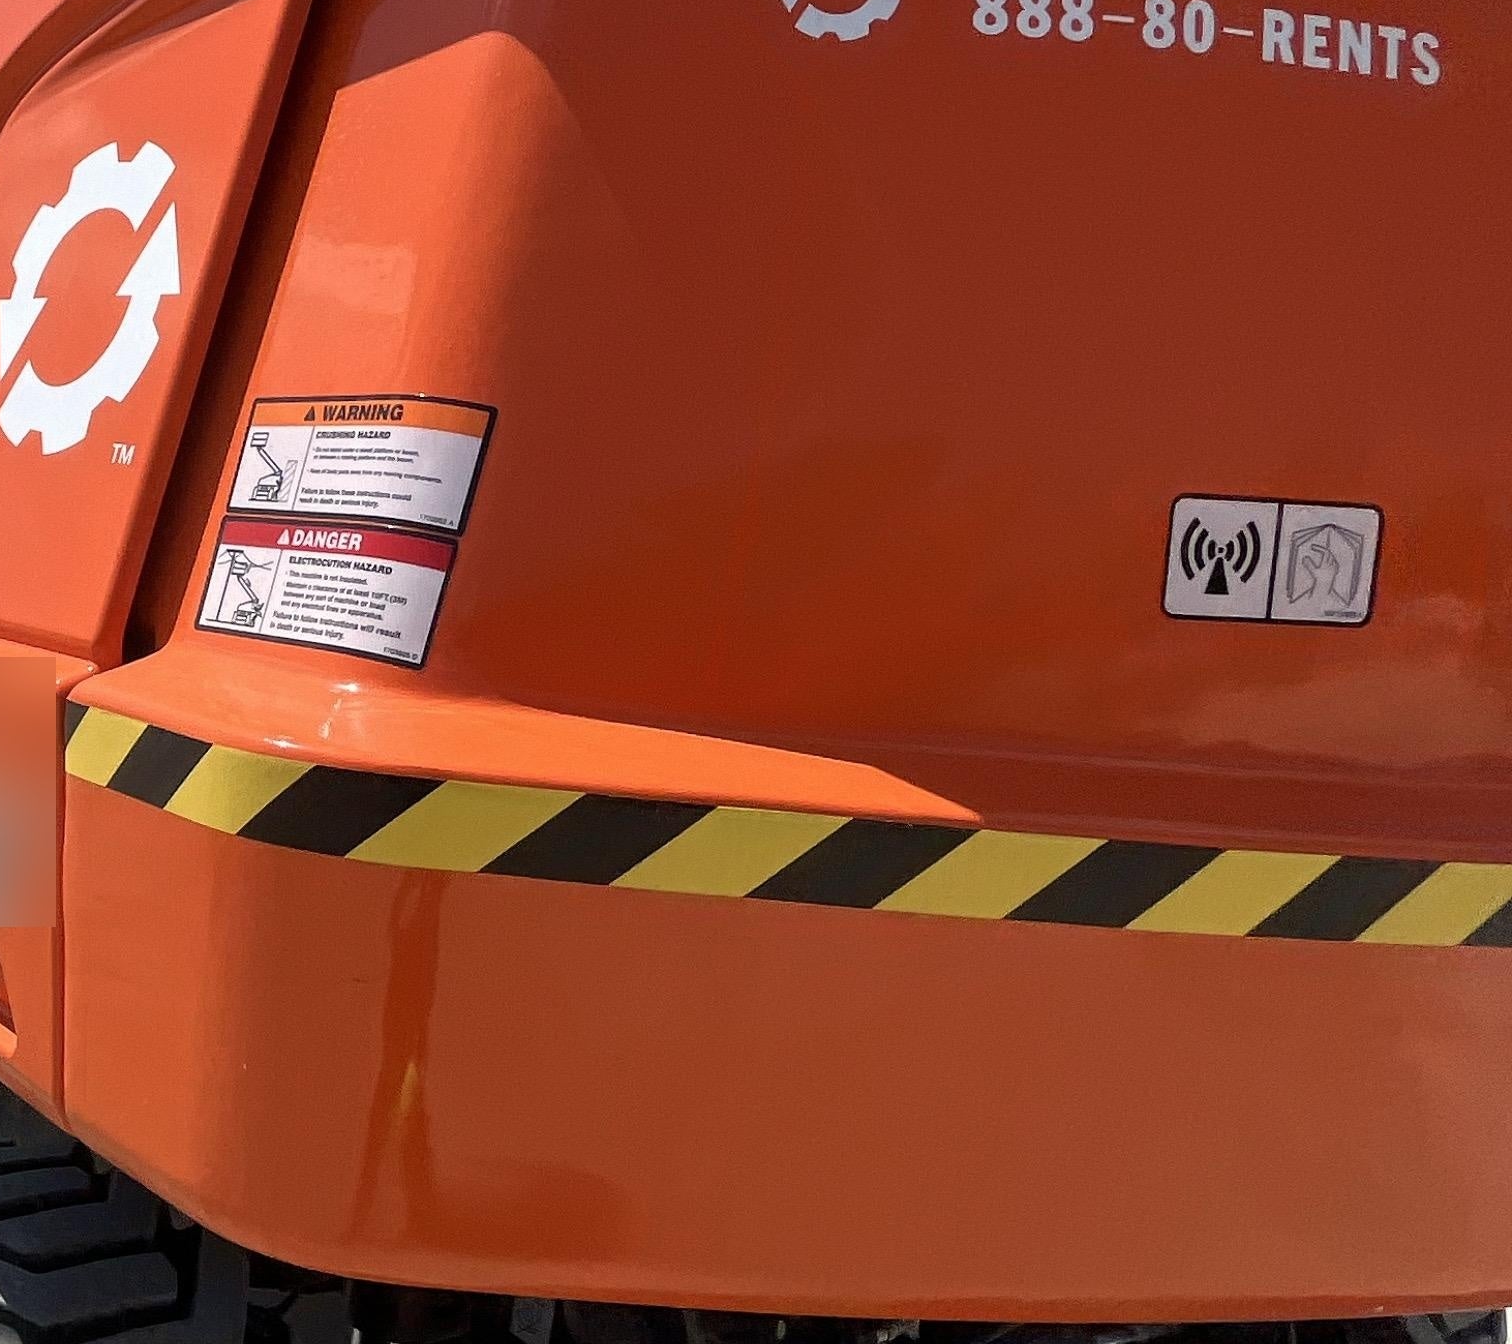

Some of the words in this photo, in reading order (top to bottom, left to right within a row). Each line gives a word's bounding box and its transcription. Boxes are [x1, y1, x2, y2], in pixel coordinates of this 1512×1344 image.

[323, 403, 404, 422] WARNING
[291, 529, 363, 552] DANGER
[289, 556, 352, 571] ELECTROCUTION
[353, 558, 393, 575] HAZARD
